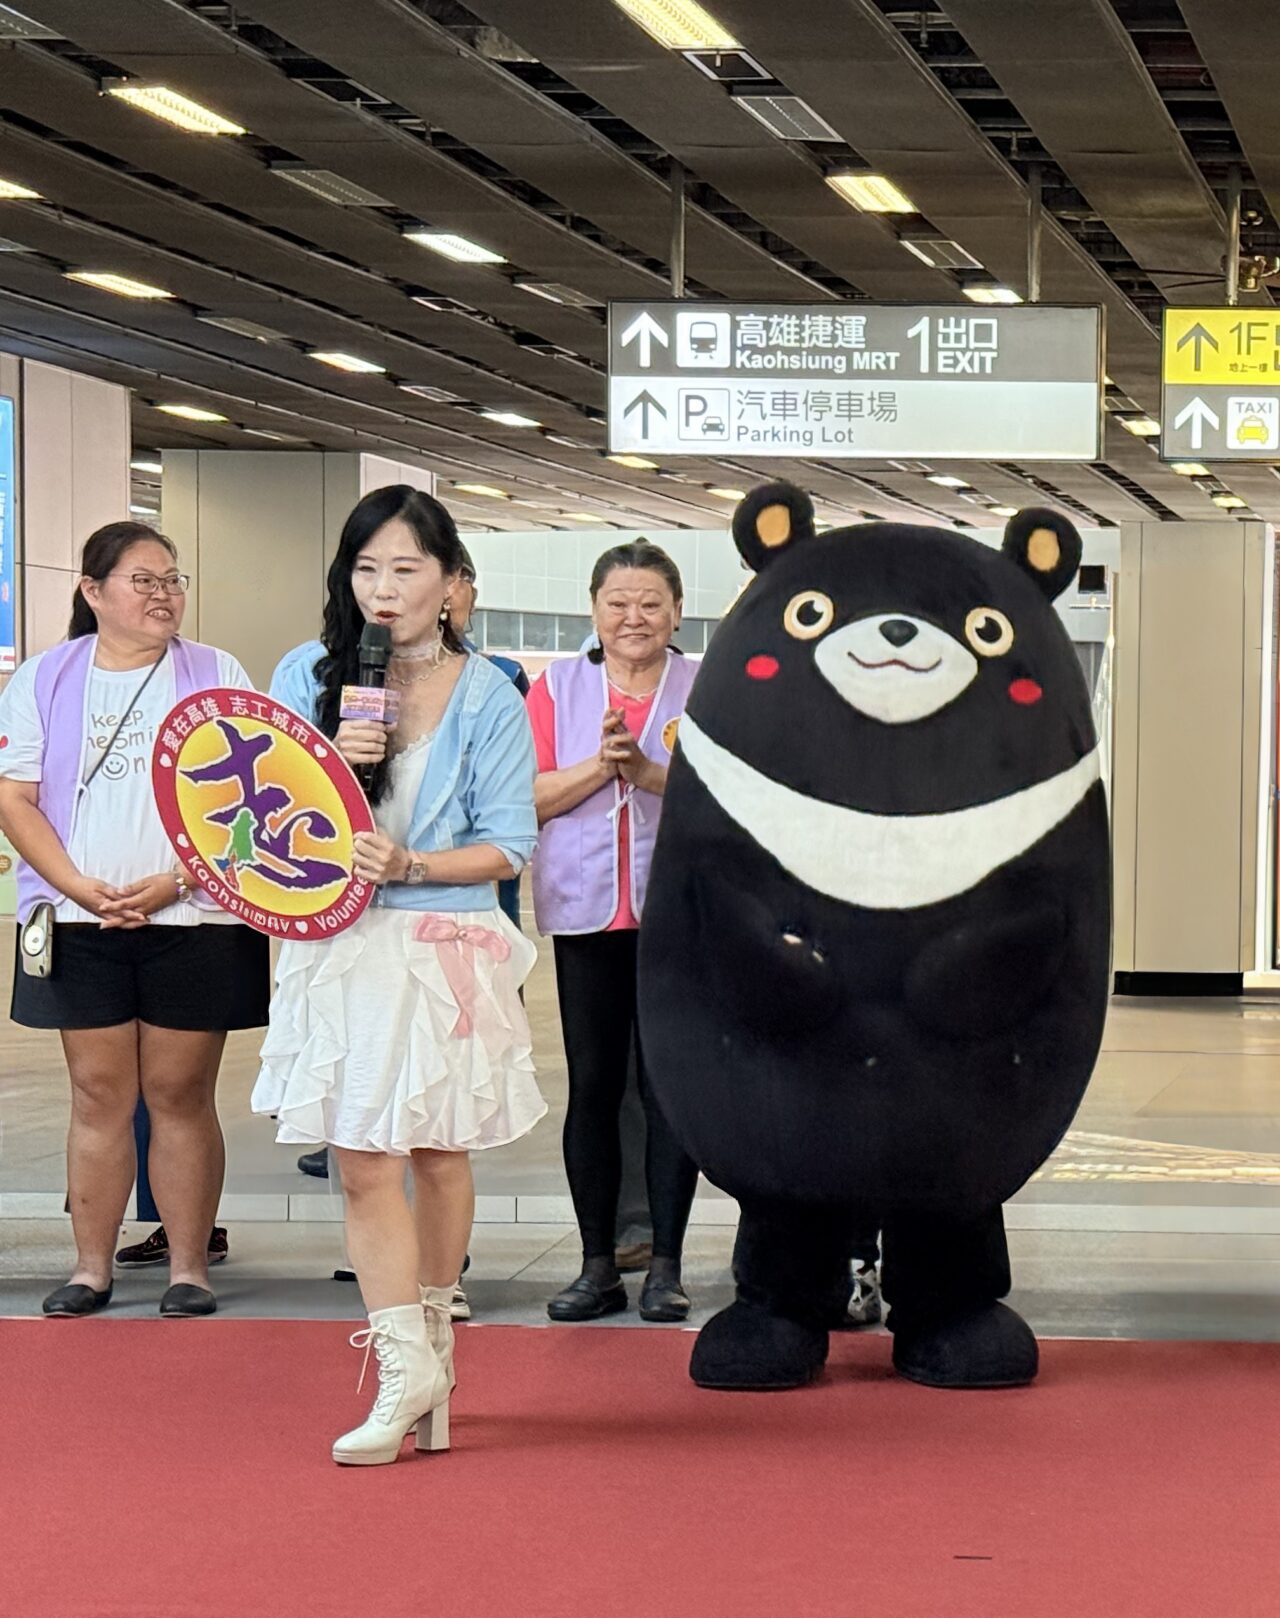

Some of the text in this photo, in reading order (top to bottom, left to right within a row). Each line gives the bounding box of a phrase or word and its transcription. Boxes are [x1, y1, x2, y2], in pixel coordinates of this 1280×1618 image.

[735, 313, 867, 349] 高雄捷運
[906, 316, 930, 373] 1
[937, 317, 999, 350] 出口
[735, 350, 900, 373] Kaohsiung MRT
[937, 351, 998, 374] EXIT
[737, 389, 898, 423] 汽車停車場
[1235, 401, 1273, 414] TAXI
[737, 425, 854, 447] Parking Lot
[91, 710, 143, 728] keep
[161, 696, 222, 754] 愛在高雄
[228, 695, 311, 745] 志工城市
